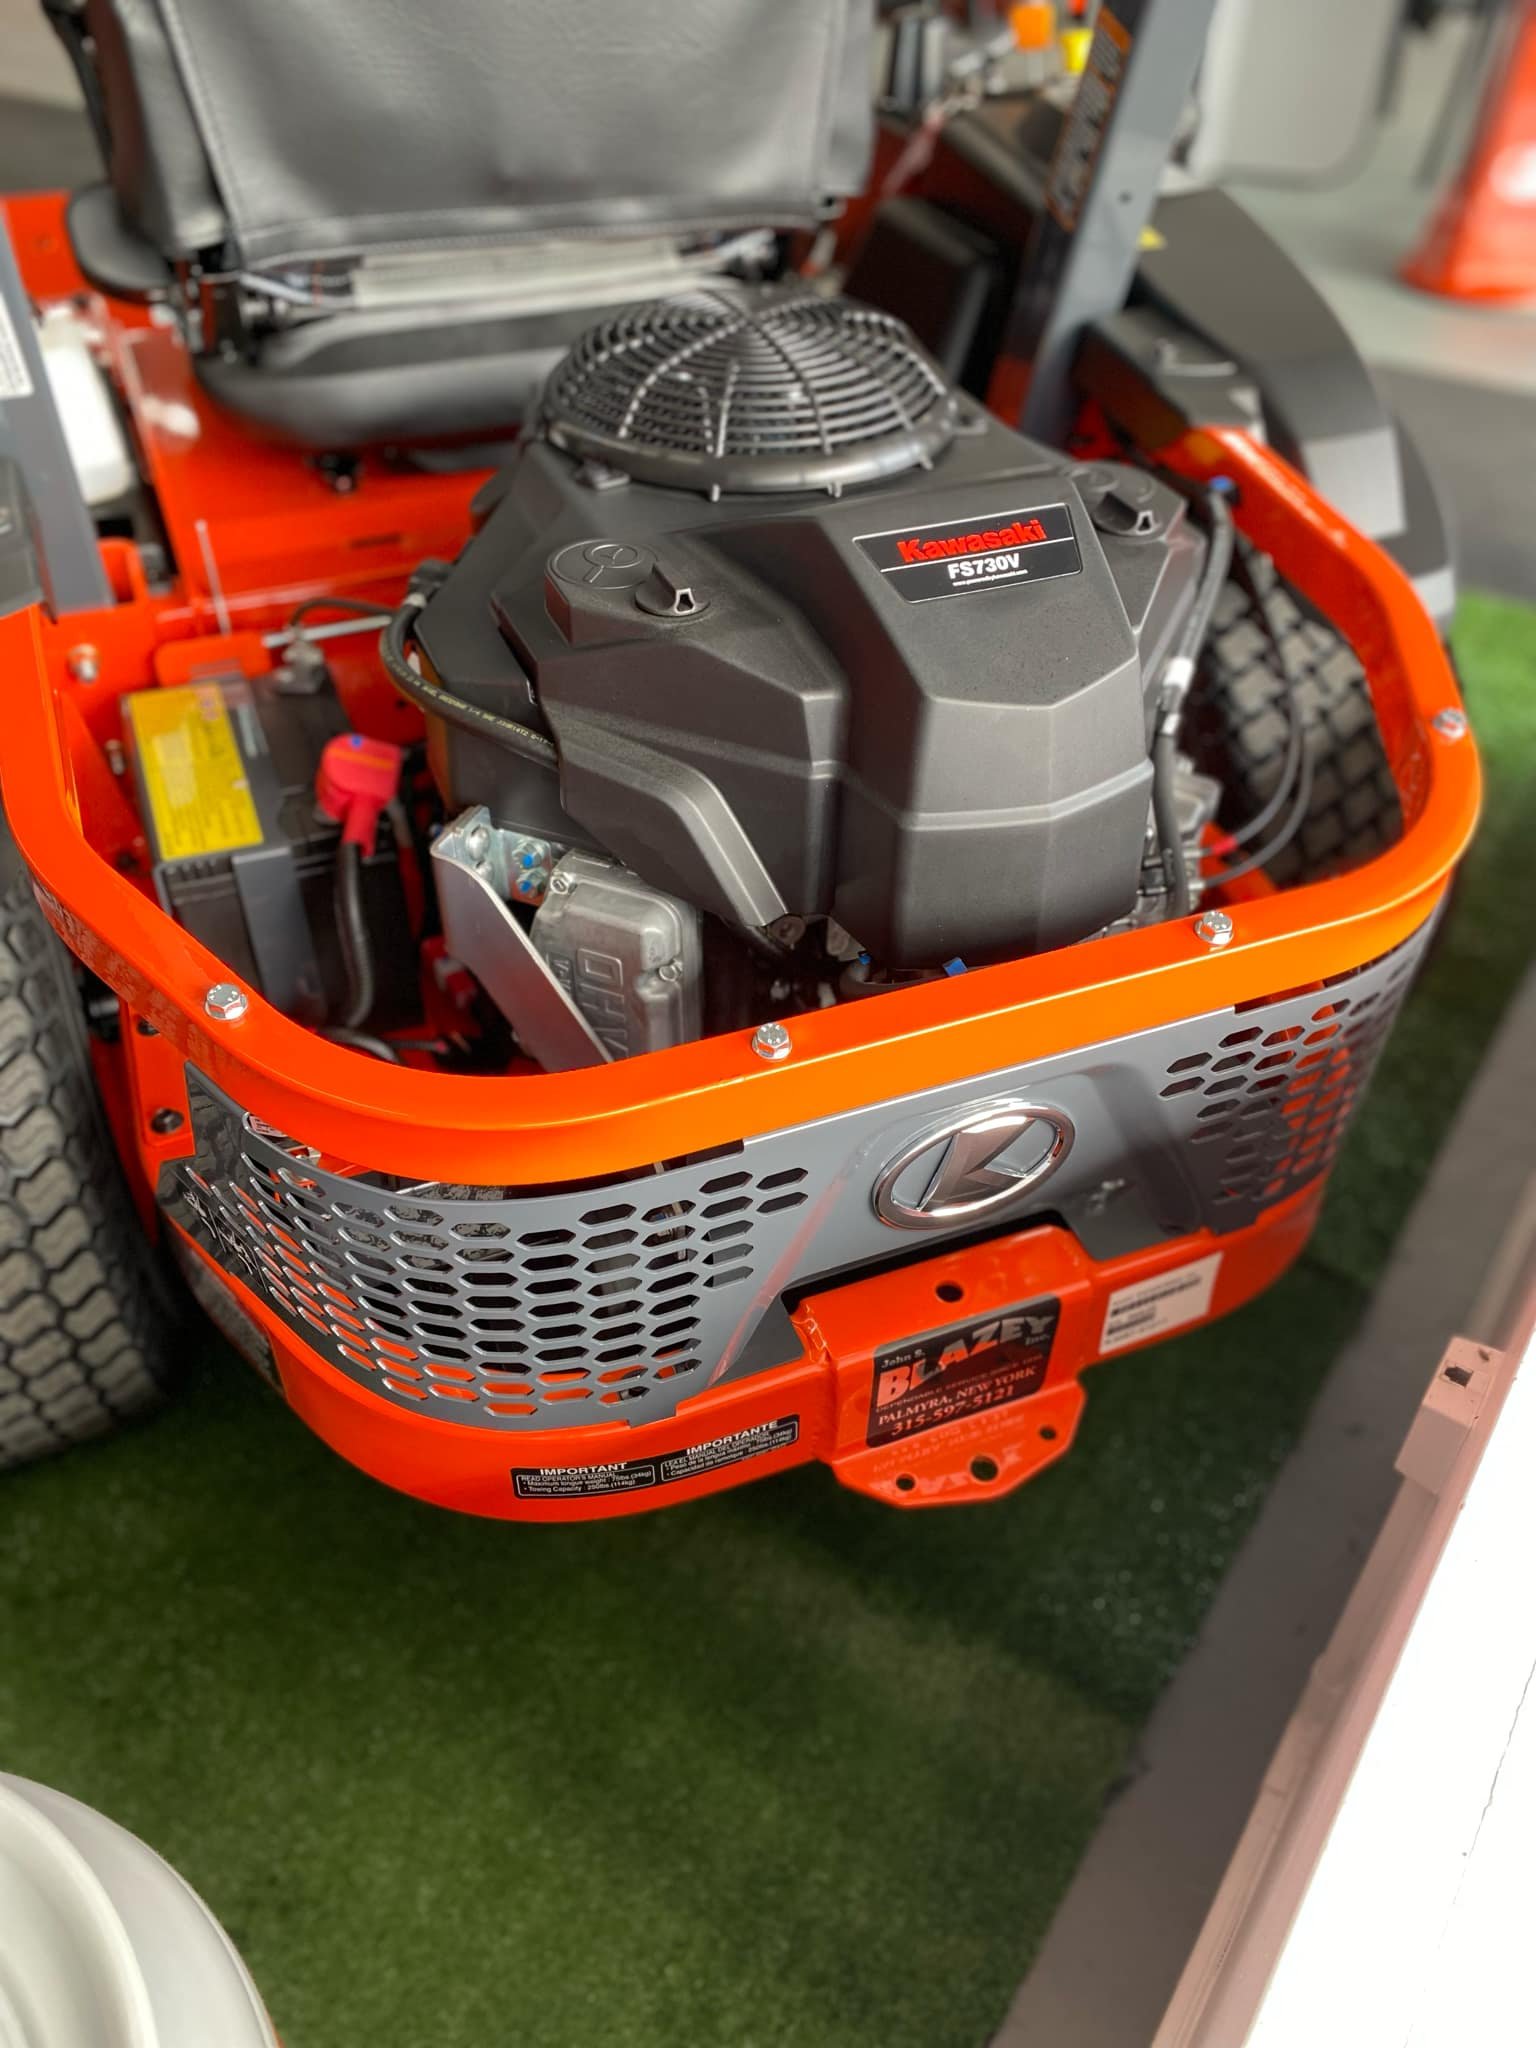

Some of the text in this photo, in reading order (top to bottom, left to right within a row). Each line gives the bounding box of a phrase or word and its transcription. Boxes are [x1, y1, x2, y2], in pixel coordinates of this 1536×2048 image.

[897, 519, 1047, 563] Kawasaki
[948, 553, 1020, 580] FS730V
[576, 948, 629, 1058] OHV
[877, 1316, 1055, 1407] BLAZEY
[881, 1354, 912, 1369] John
[878, 1365, 1037, 1425] PALMYRA, NEW YORK
[891, 1385, 1014, 1436] 315-597-5121
[686, 1420, 778, 1455] IMPORTANTE
[540, 1462, 628, 1476] IMPORTANT
